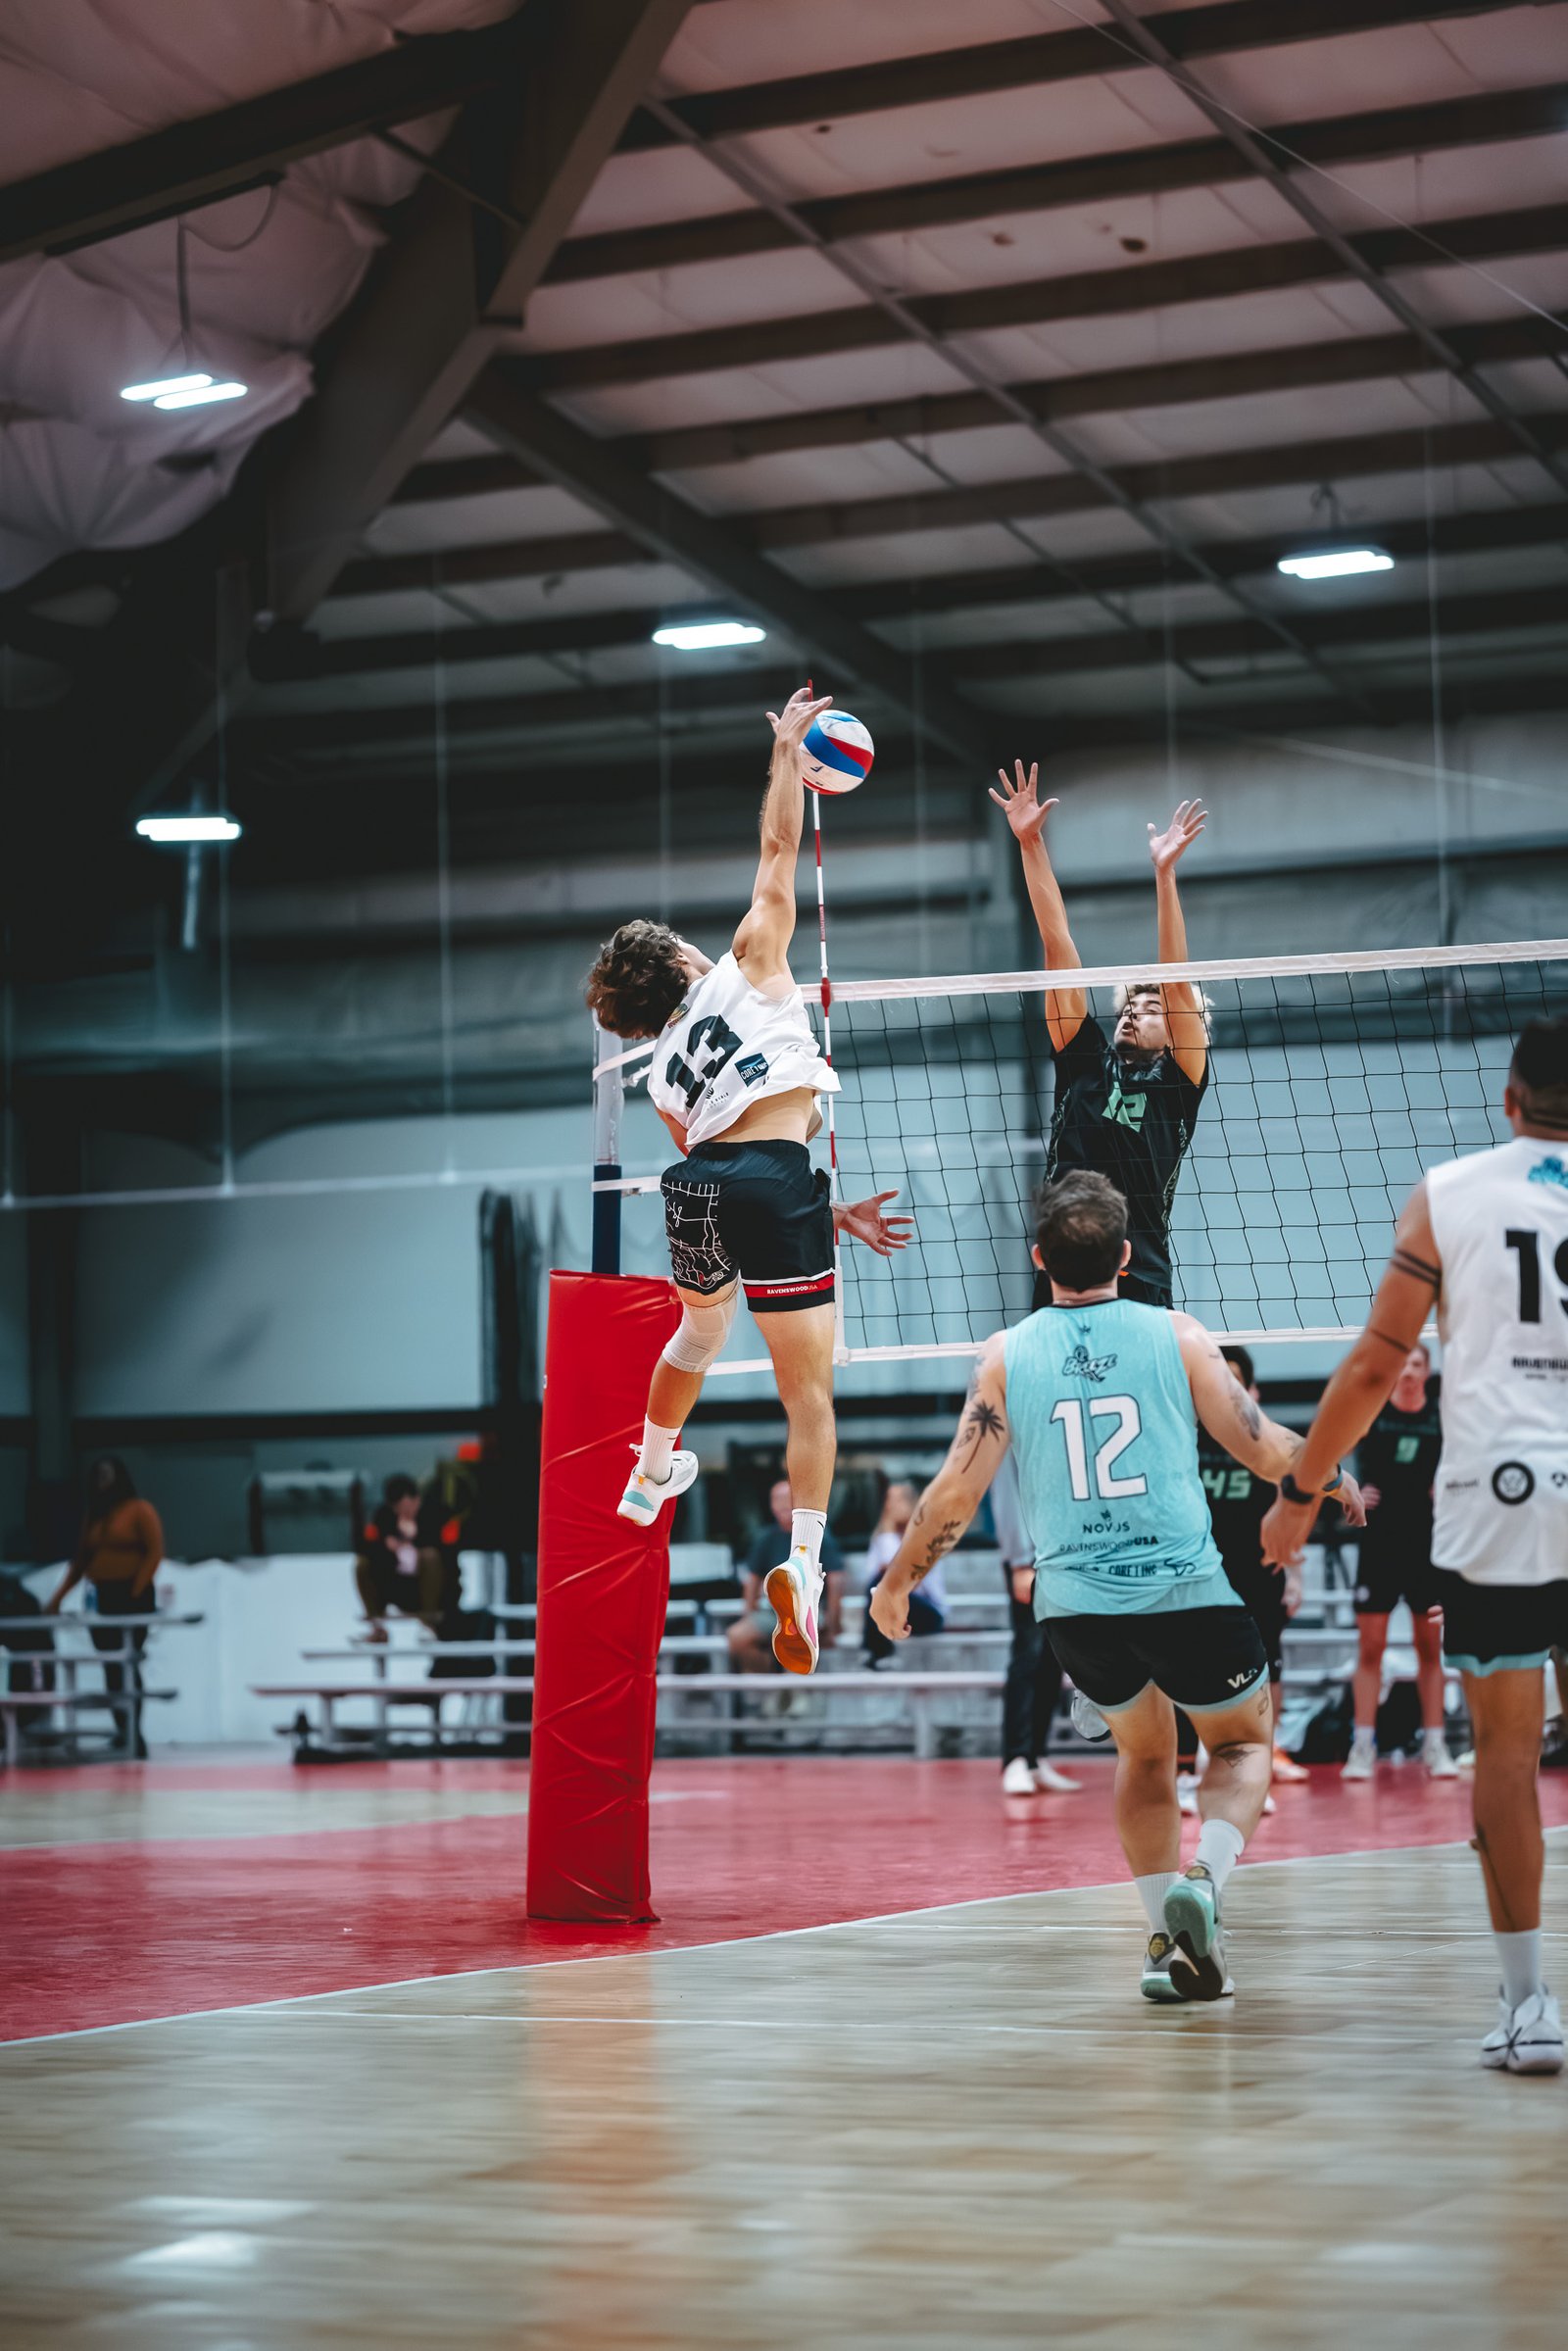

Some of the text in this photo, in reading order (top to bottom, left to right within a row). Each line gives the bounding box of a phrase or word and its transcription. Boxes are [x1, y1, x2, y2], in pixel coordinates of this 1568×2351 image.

[665, 1014, 744, 1108] 13
[740, 1066, 756, 1080] CORE
[1049, 1393, 1149, 1501] 12
[1201, 1469, 1251, 1499] 45
